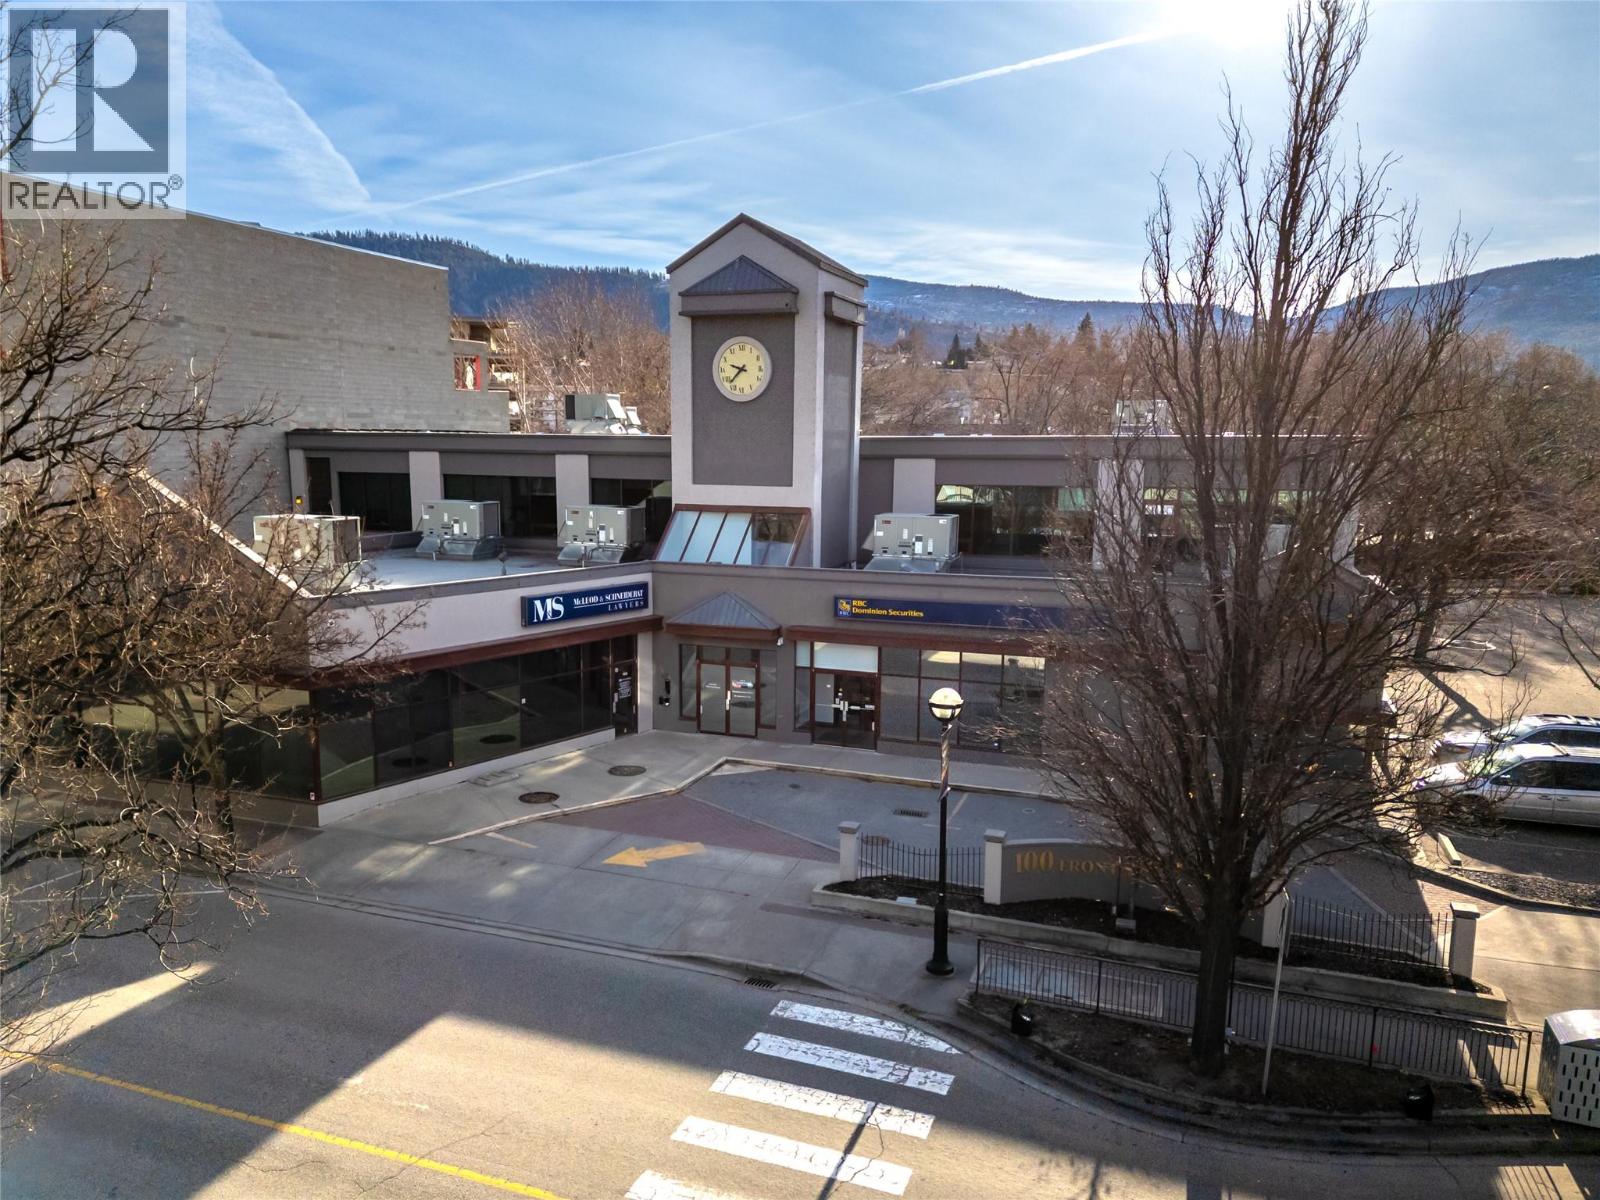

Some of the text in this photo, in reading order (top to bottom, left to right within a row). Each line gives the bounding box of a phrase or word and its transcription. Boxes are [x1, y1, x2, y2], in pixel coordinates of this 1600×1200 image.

[852, 607, 924, 617] Dominion Securities
[1016, 850, 1054, 873] 100
